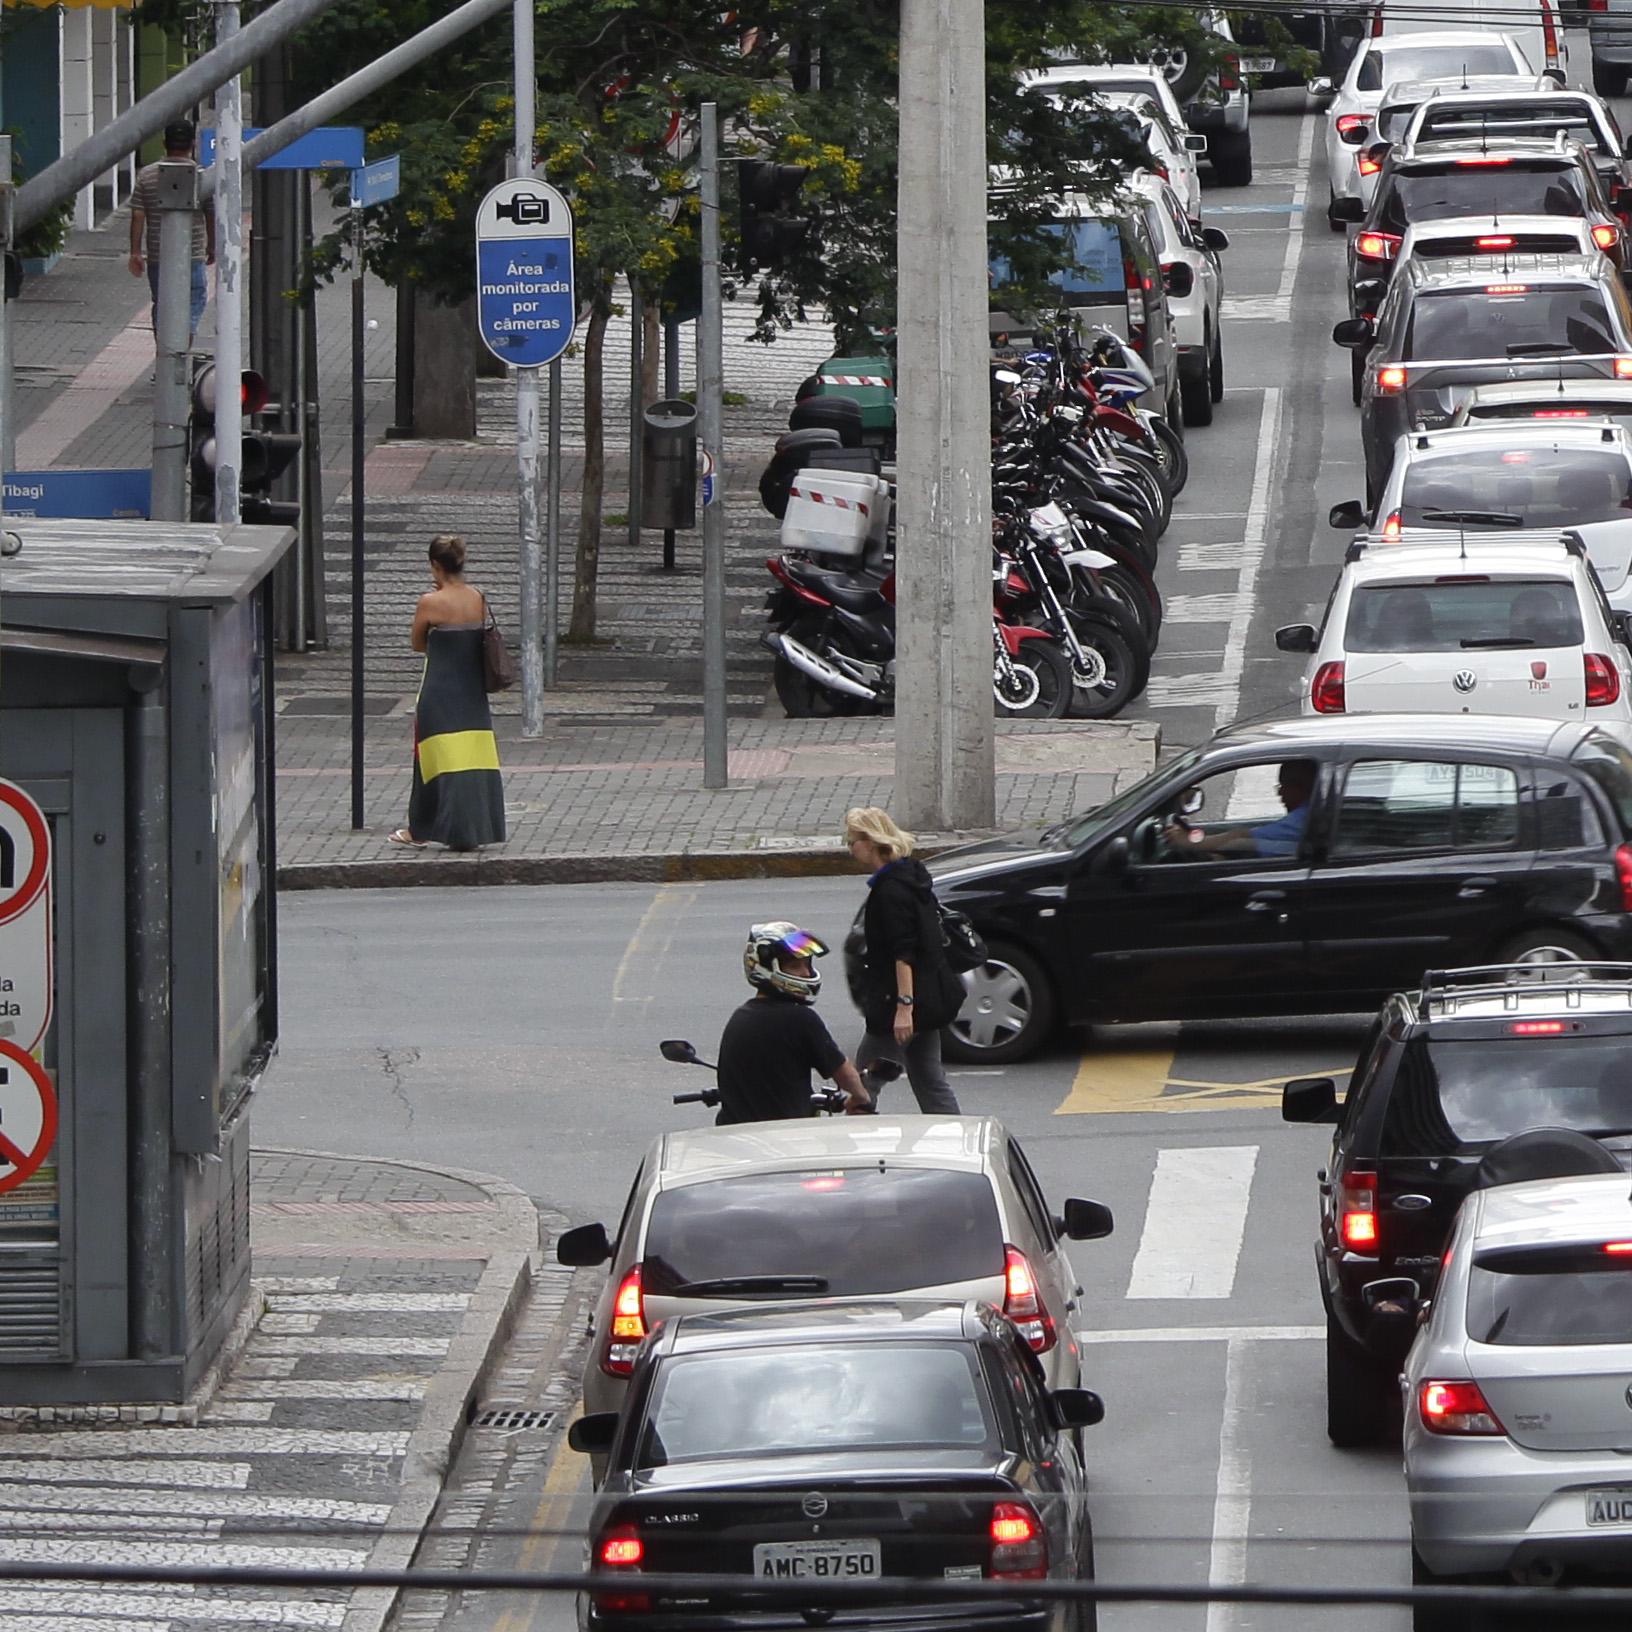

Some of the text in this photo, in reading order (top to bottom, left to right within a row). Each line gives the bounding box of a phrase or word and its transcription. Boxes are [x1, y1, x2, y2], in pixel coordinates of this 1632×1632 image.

[506, 260, 544, 276] Área
[482, 282, 570, 295] monitorada
[512, 301, 541, 315] por
[493, 317, 560, 331] câmeras
